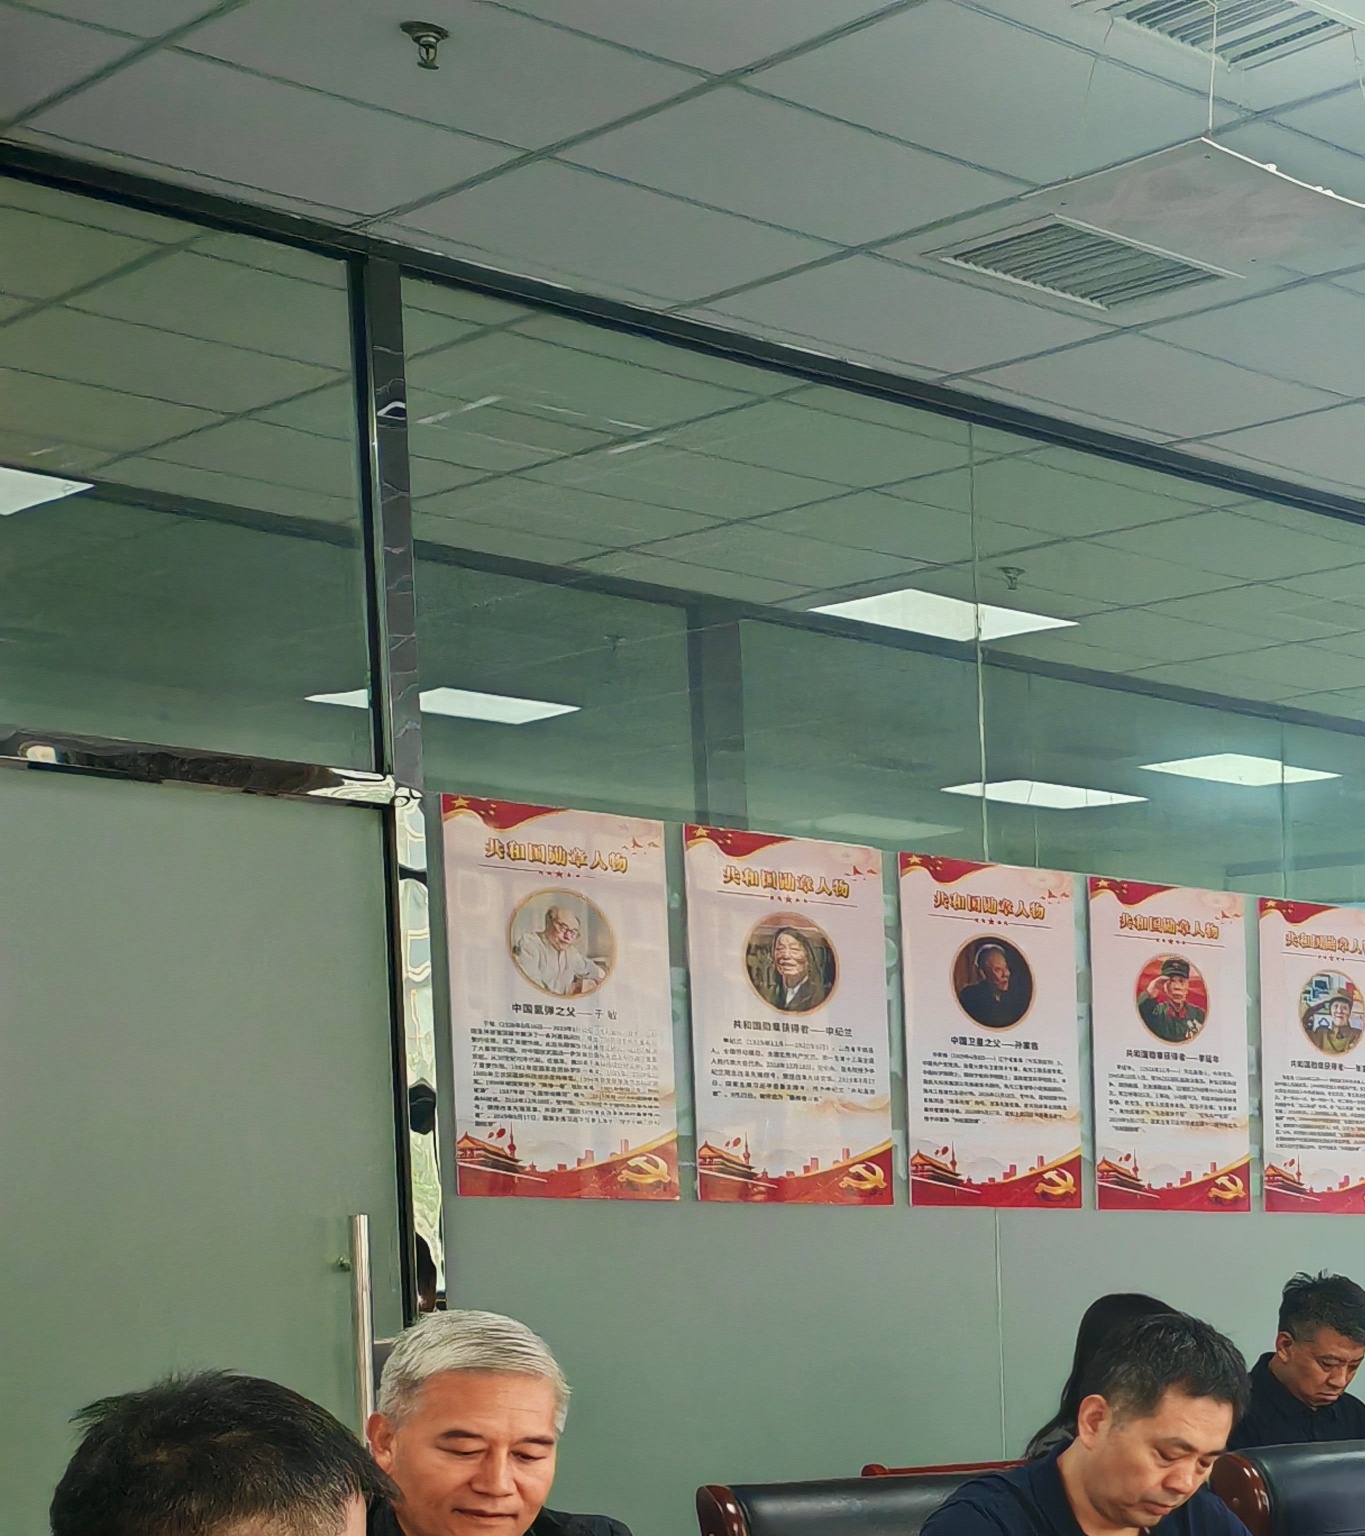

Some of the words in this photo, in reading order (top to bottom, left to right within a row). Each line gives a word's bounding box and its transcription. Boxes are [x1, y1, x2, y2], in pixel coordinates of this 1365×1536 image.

[484, 837, 630, 875] 共和国勋章人物
[722, 864, 851, 899] 共和国勋章人物
[933, 889, 1046, 921] 共和国勋章人物
[1119, 912, 1220, 940] 共和国勋章人物
